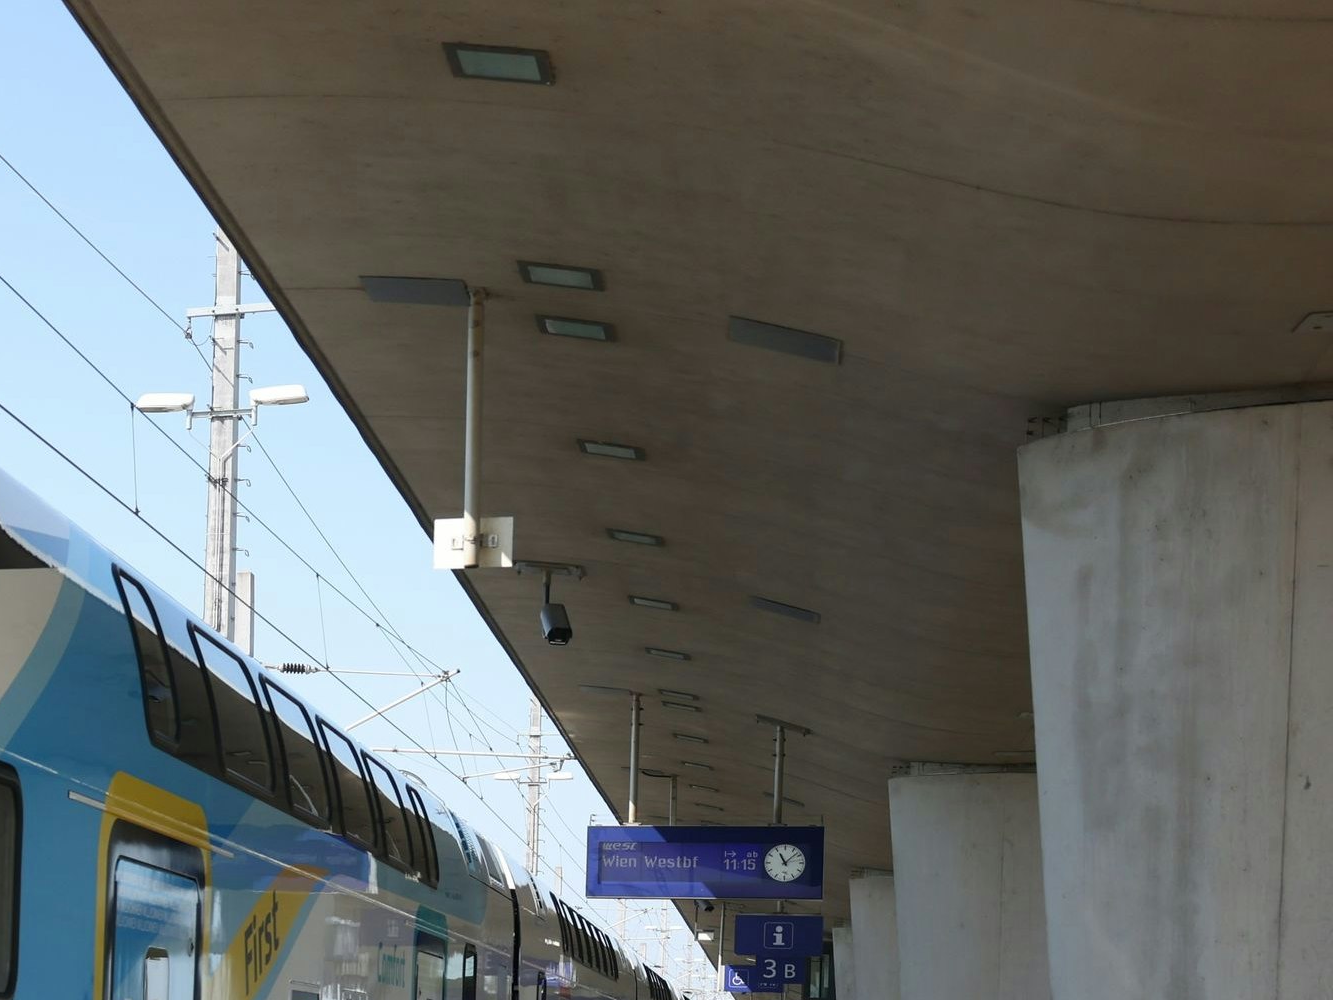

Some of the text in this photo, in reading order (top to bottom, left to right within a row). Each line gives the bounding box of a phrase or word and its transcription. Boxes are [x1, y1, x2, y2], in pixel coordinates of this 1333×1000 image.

[602, 854, 699, 869] Wien Westbf
[746, 850, 759, 859] ab
[723, 858, 757, 871] 11:15
[244, 889, 280, 997] First
[762, 959, 797, 979] 3 B
